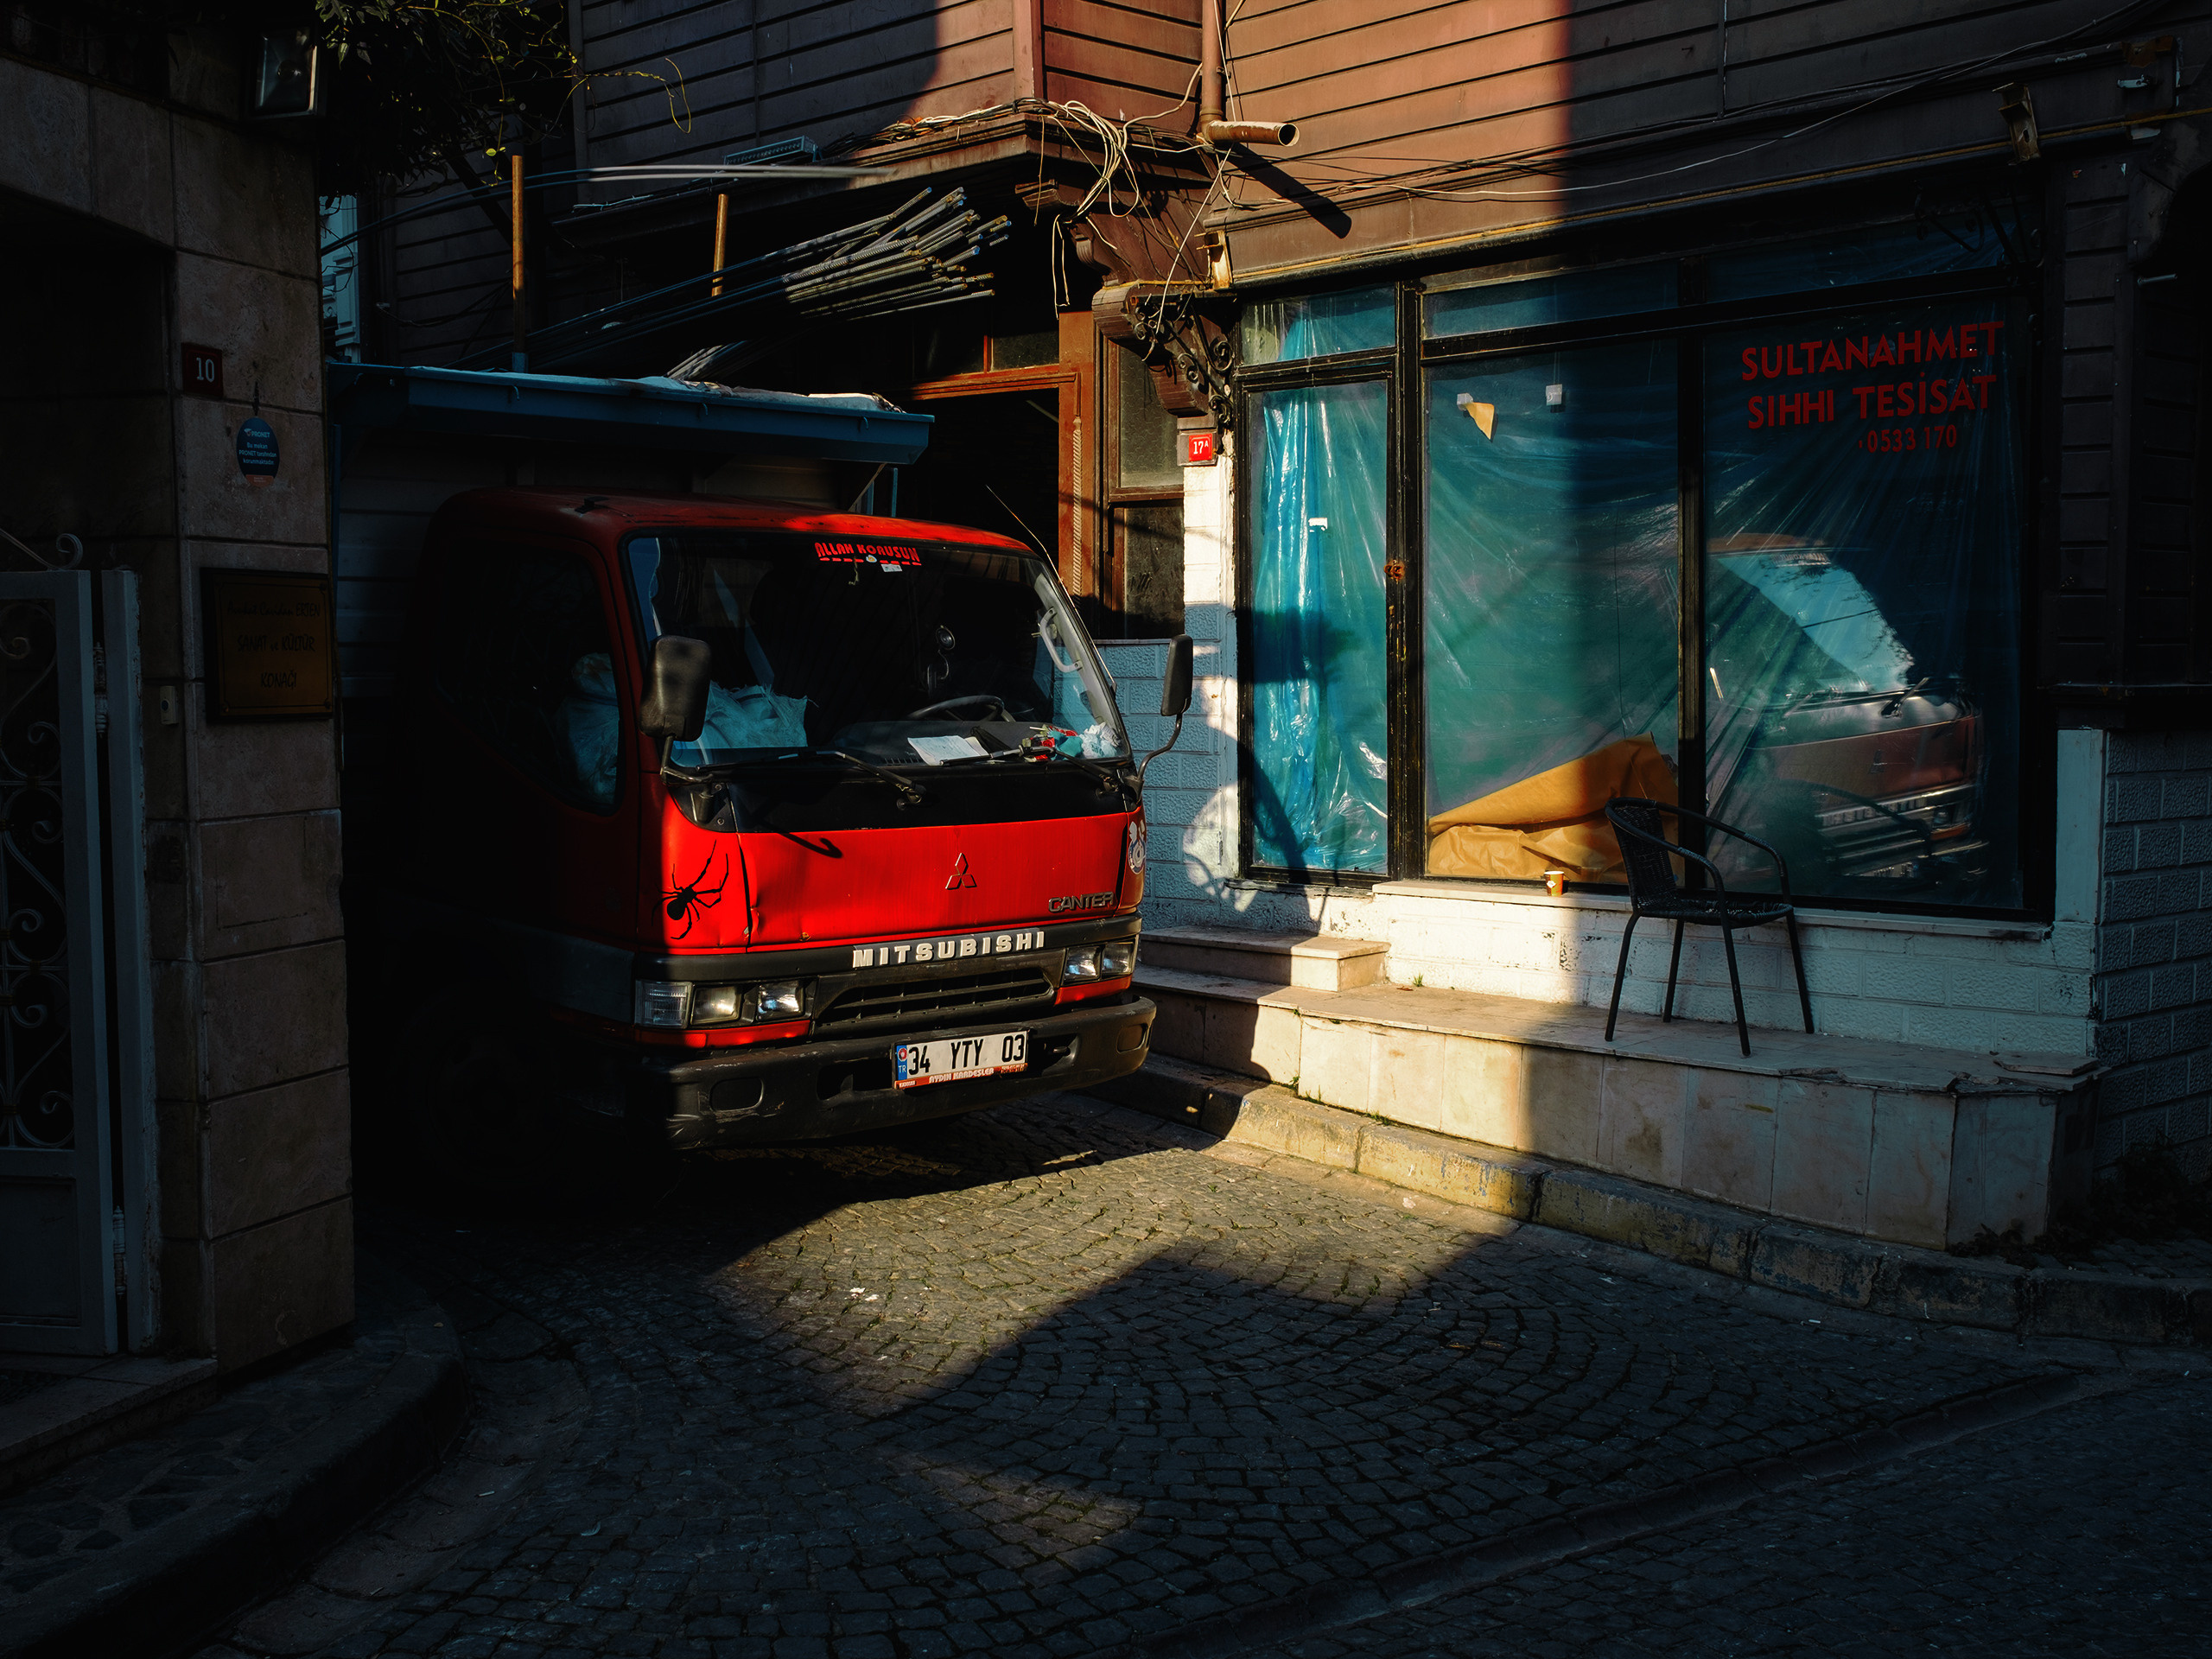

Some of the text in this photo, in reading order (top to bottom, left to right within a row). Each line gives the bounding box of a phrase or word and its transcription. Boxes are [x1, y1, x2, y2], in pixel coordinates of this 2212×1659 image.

[1742, 321, 2004, 380] SULTANAHMET
[195, 357, 215, 383] 10
[1748, 372, 1997, 429] SIHHI TESİSAT
[251, 430, 270, 439] PRONET
[1866, 424, 1957, 453] 0533 170
[815, 542, 920, 562] ALLAH KORUSUN
[237, 634, 267, 652] SANAT
[282, 632, 315, 652] KÜLTÜR
[260, 671, 297, 690] KONAĞI
[1048, 892, 1115, 912] CANTER
[853, 931, 1045, 969] MITSUBISHI
[908, 1034, 1024, 1076] 34 YTY 03
[898, 1065, 906, 1073] TR
[929, 1073, 952, 1084] AYDIN
